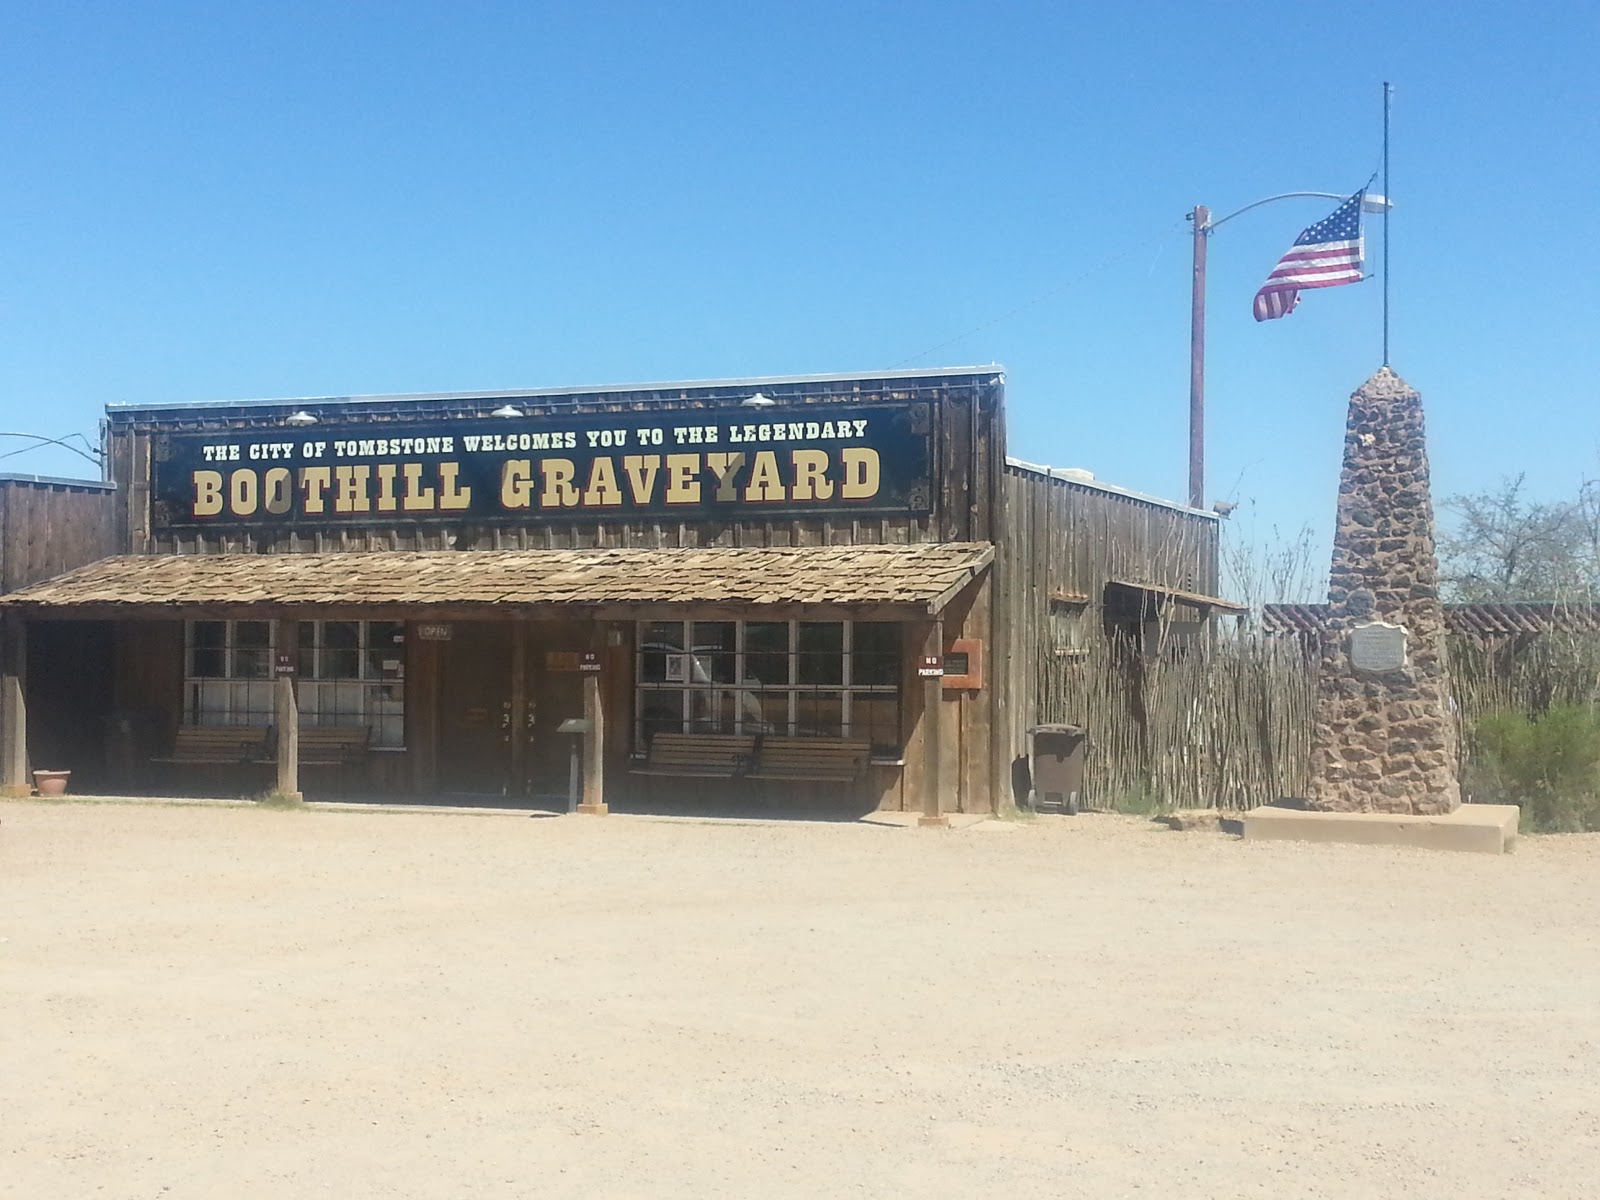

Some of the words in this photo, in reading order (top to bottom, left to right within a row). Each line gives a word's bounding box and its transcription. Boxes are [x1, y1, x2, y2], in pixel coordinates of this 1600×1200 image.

[203, 444, 240, 461] THE
[249, 442, 294, 460] CITY
[302, 441, 327, 458] OF
[334, 436, 454, 457] TOMBSTONE
[463, 431, 577, 452] WELCOMES
[586, 429, 627, 448] YOU
[637, 428, 664, 446] TO
[673, 426, 718, 444] THE
[729, 419, 868, 443] LEGENDARY
[191, 461, 471, 517] BOOTHILL
[499, 447, 881, 511] GRAVEYARD
[918, 668, 944, 676] PARKING
